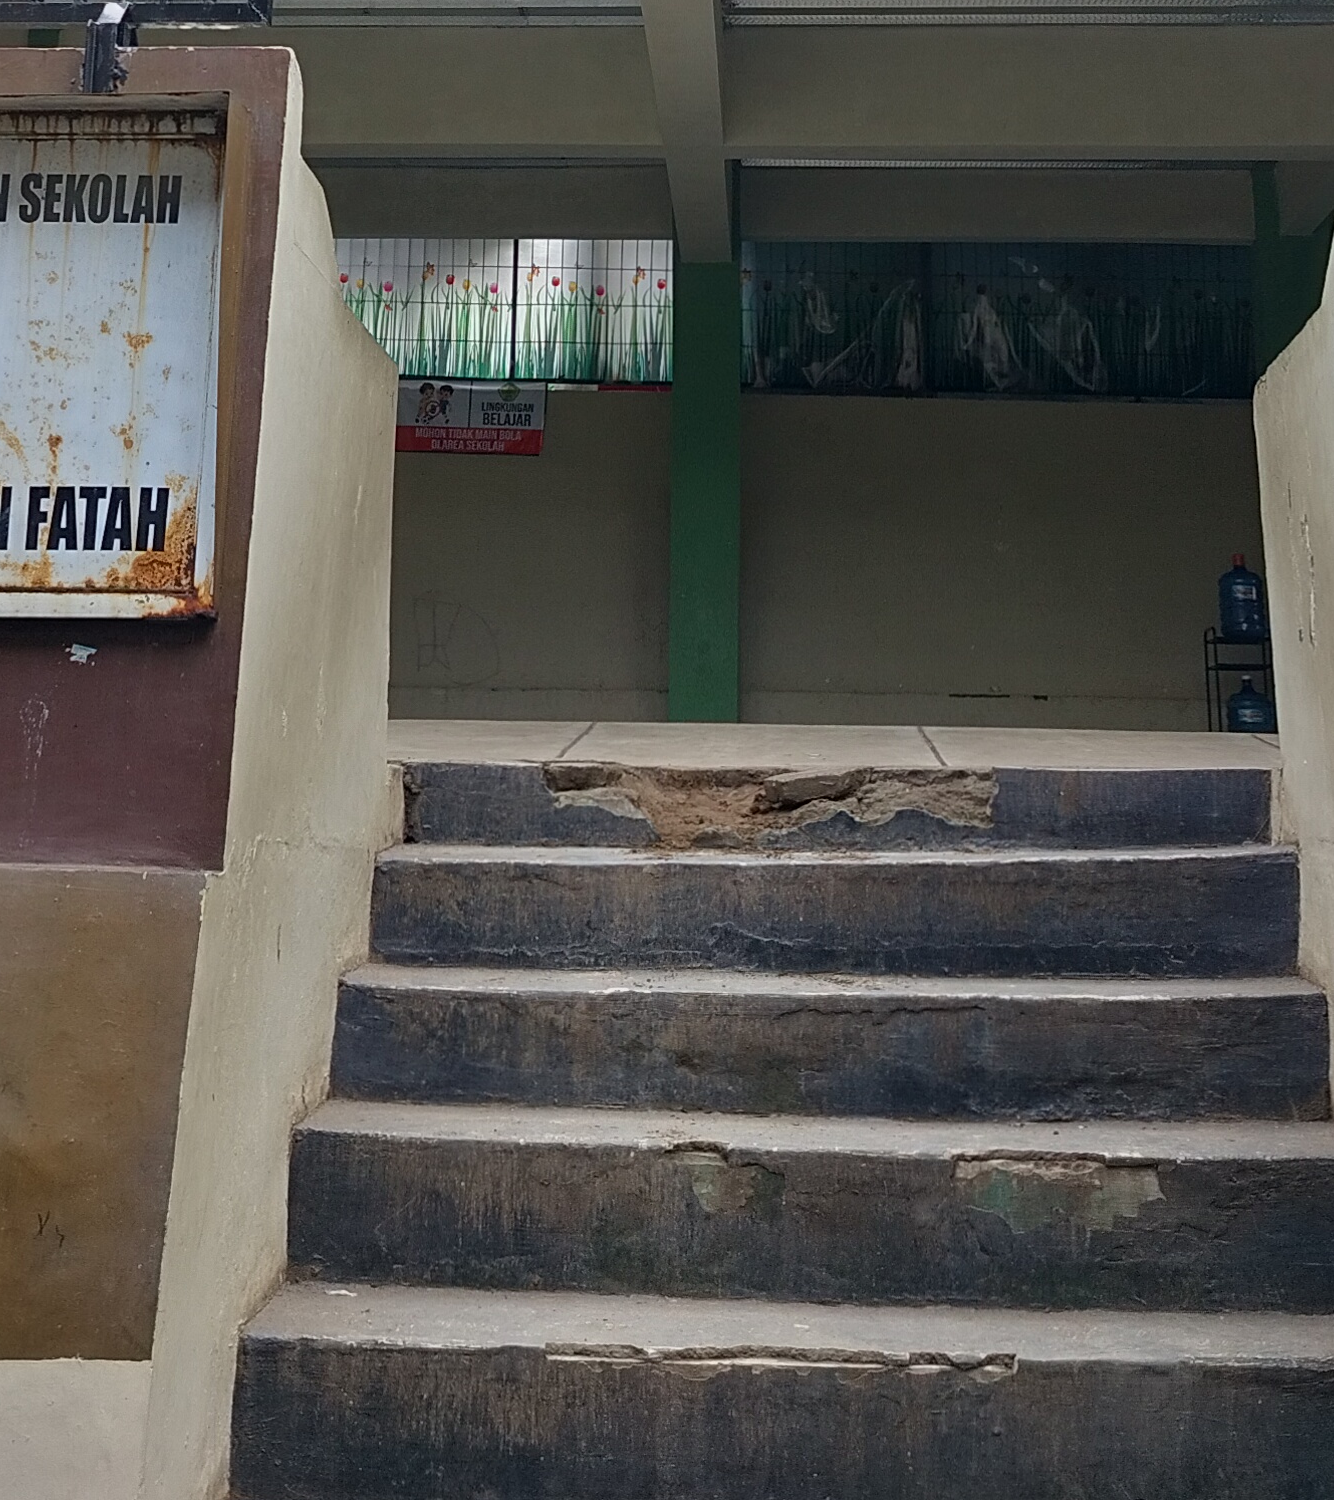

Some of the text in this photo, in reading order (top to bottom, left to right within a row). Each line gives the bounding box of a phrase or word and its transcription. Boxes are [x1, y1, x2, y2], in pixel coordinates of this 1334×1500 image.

[19, 174, 182, 224] SEKOLAH
[481, 402, 534, 413] LINGKUNGAN
[483, 412, 531, 427] BELAJAR
[415, 427, 522, 441] MOHON TIDAK MAIN BOLA
[466, 440, 505, 451] SEKOLAH
[24, 486, 169, 552] FATAH
